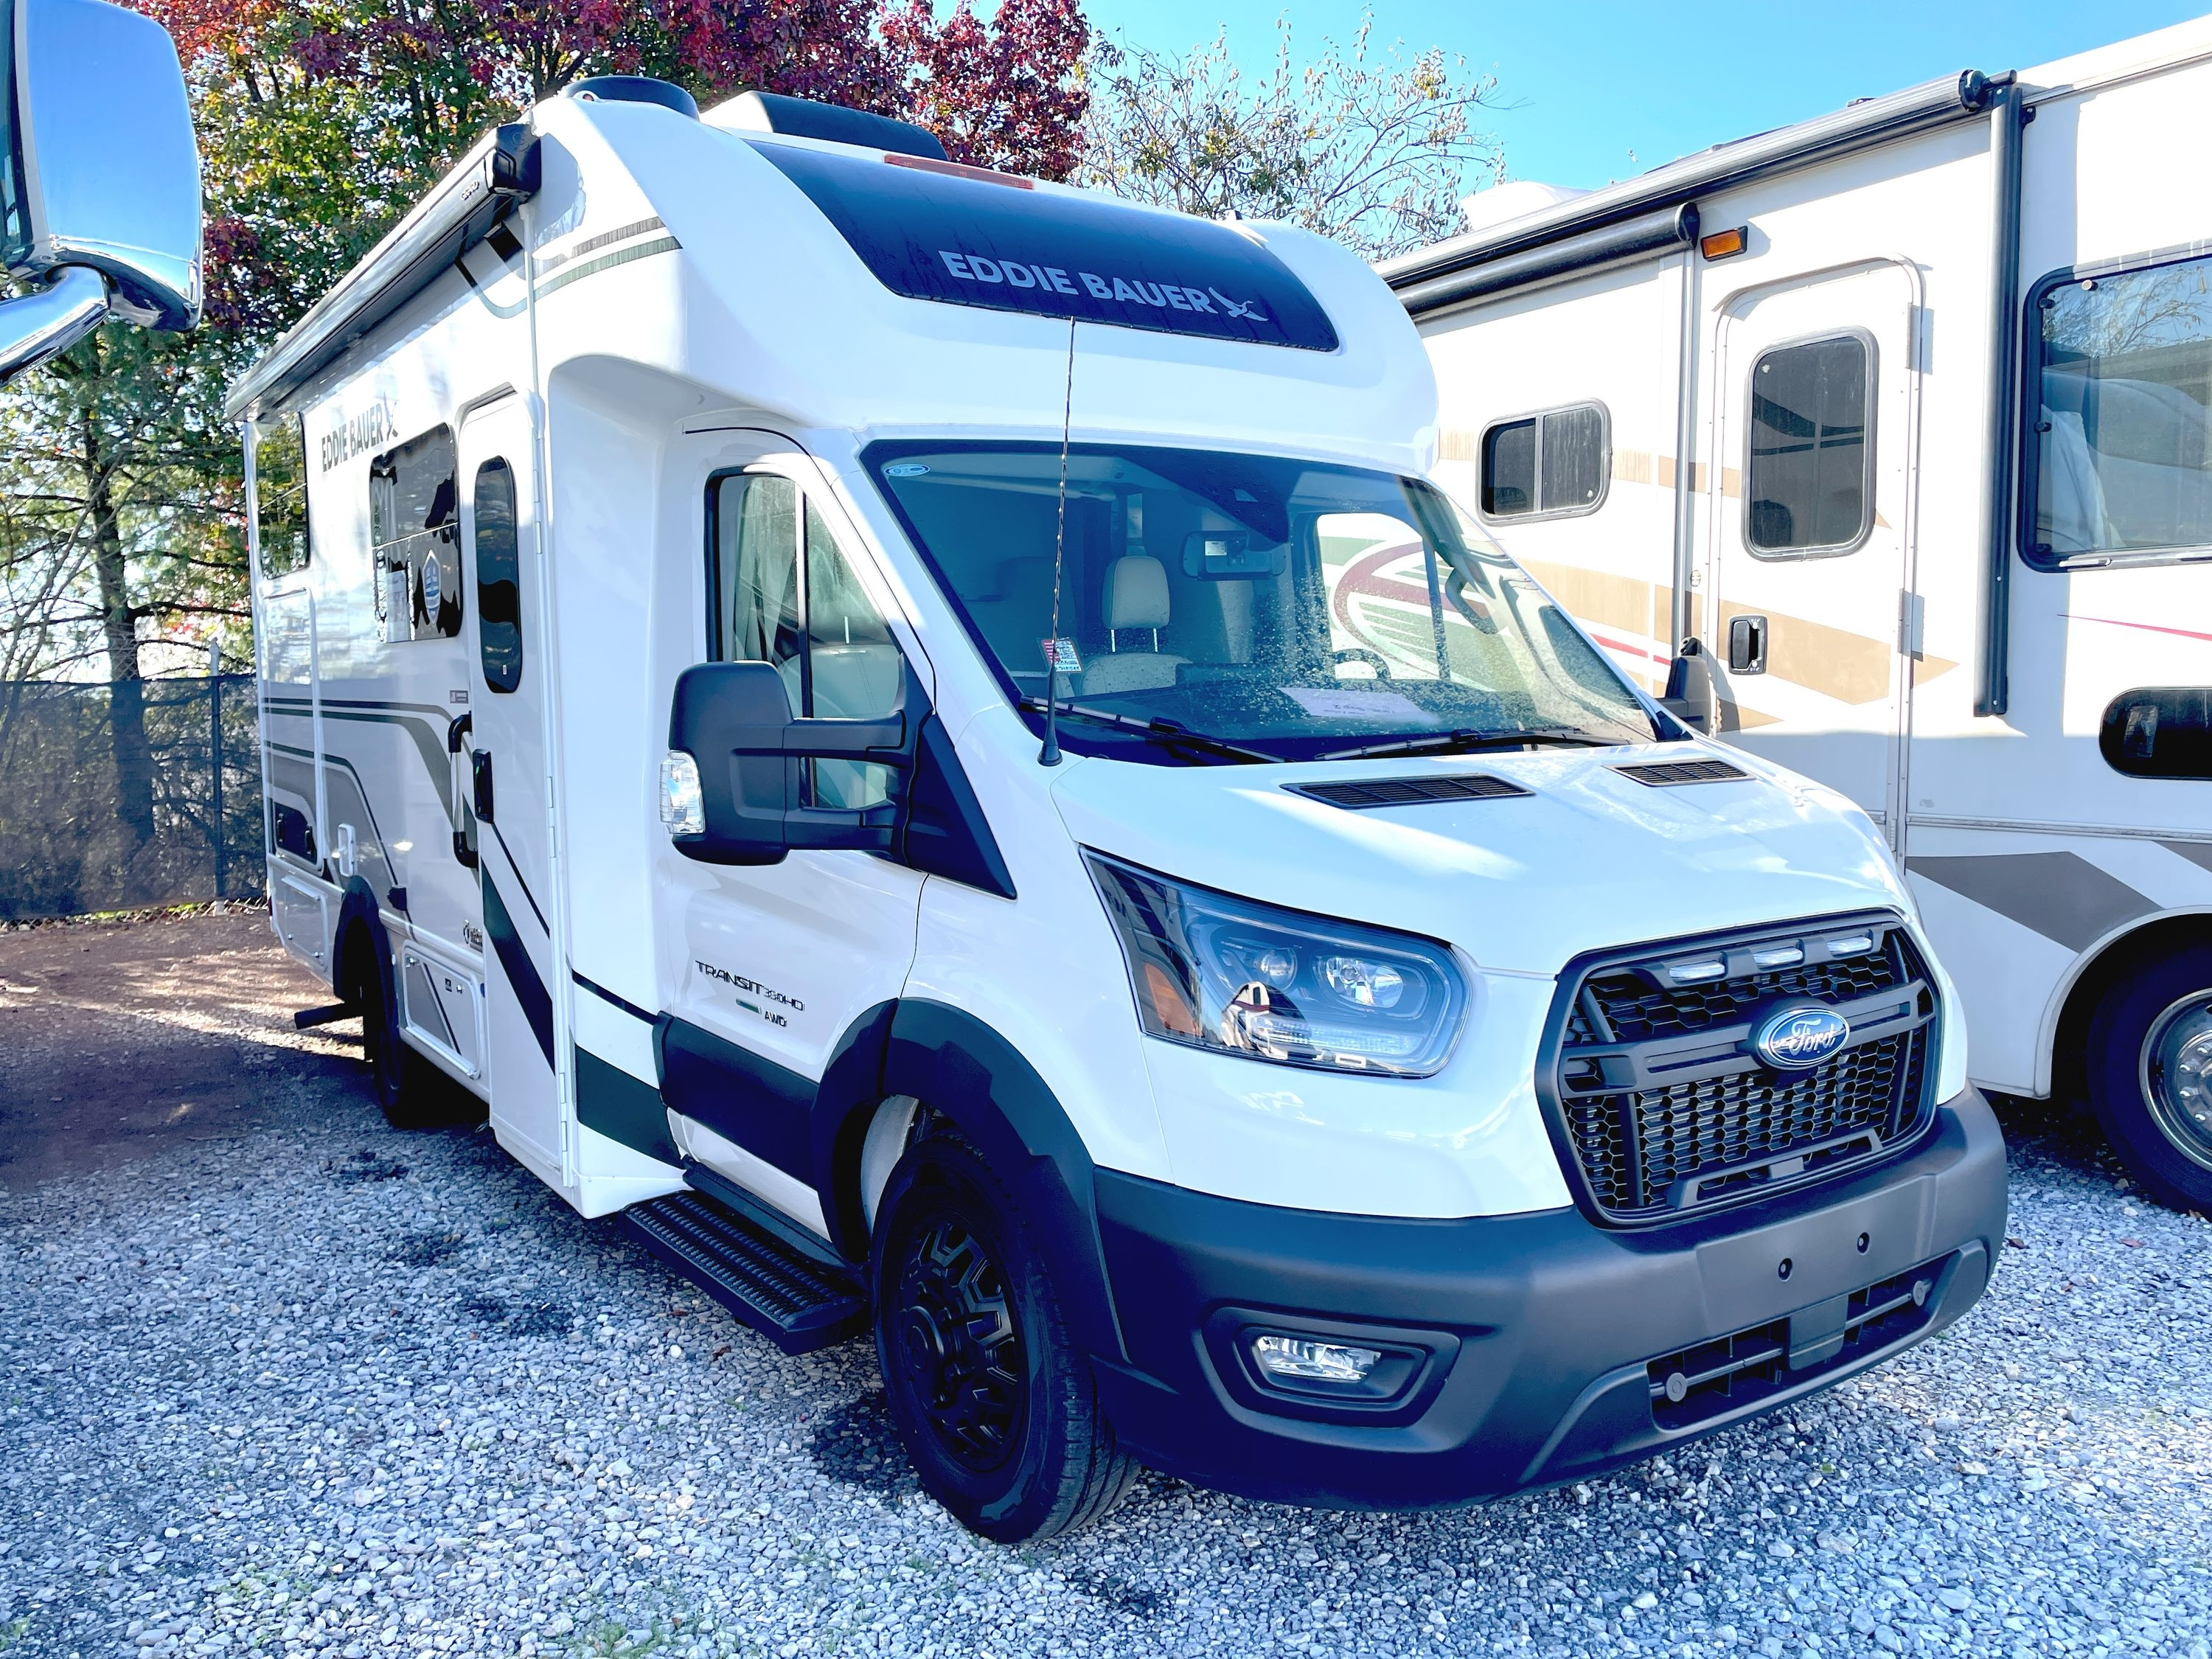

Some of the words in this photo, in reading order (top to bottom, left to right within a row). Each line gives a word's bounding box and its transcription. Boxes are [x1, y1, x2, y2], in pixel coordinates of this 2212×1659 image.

[938, 250, 1079, 296] EDDIE
[1078, 271, 1219, 314] BAUER
[321, 422, 348, 473] EDDIE
[350, 403, 383, 458] BAUER
[695, 959, 765, 995] TRANSIT
[764, 1009, 787, 1027] AWD
[1787, 1018, 1837, 1056] Ford
